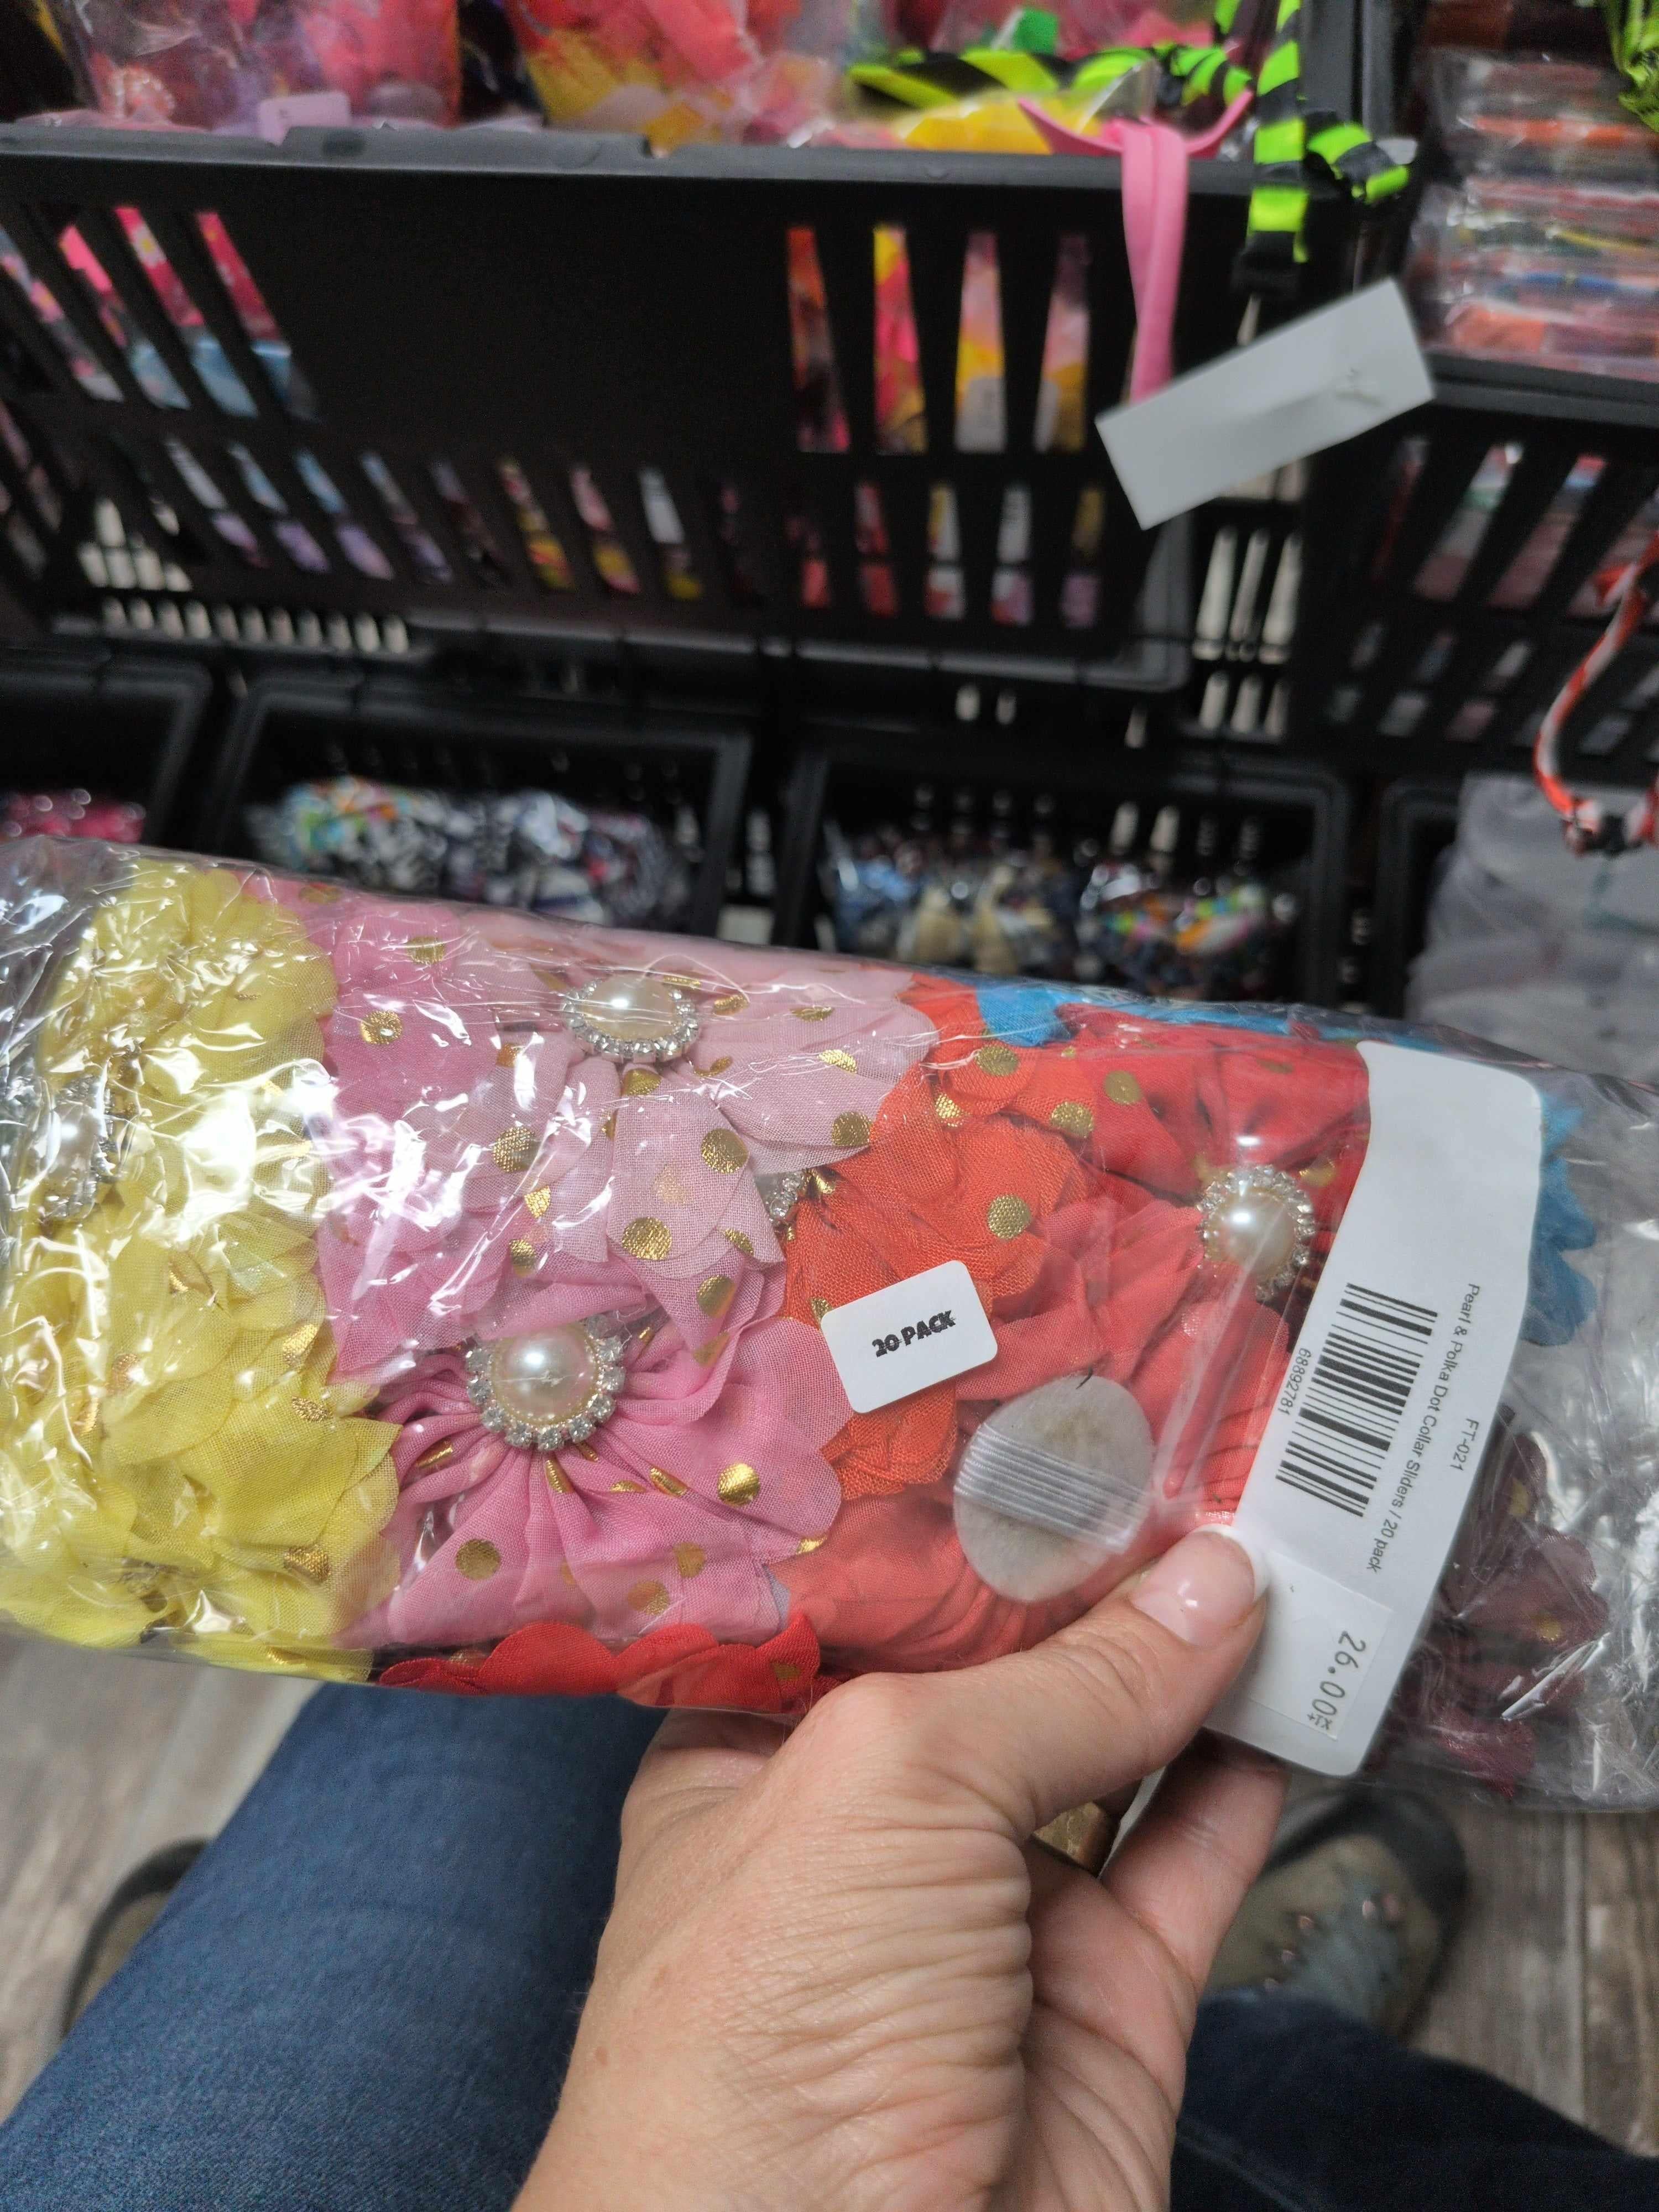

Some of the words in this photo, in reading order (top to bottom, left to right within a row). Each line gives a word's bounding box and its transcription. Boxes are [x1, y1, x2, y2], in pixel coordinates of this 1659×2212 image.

[1458, 1283, 1480, 1323] Pearl
[872, 1334, 900, 1358] 20
[901, 1310, 956, 1346] PACK
[1453, 1326, 1467, 1336] &
[1438, 1340, 1463, 1381] Polka
[1277, 1348, 1311, 1415] 68892781
[1427, 1385, 1448, 1411] Dot
[1412, 1415, 1437, 1457] Collar
[1449, 1418, 1479, 1472] FT-021
[1391, 1459, 1420, 1507] Sliders
[1381, 1519, 1397, 1538] 20
[1366, 1538, 1388, 1573] pack
[1312, 1630, 1366, 1716] 26.00
